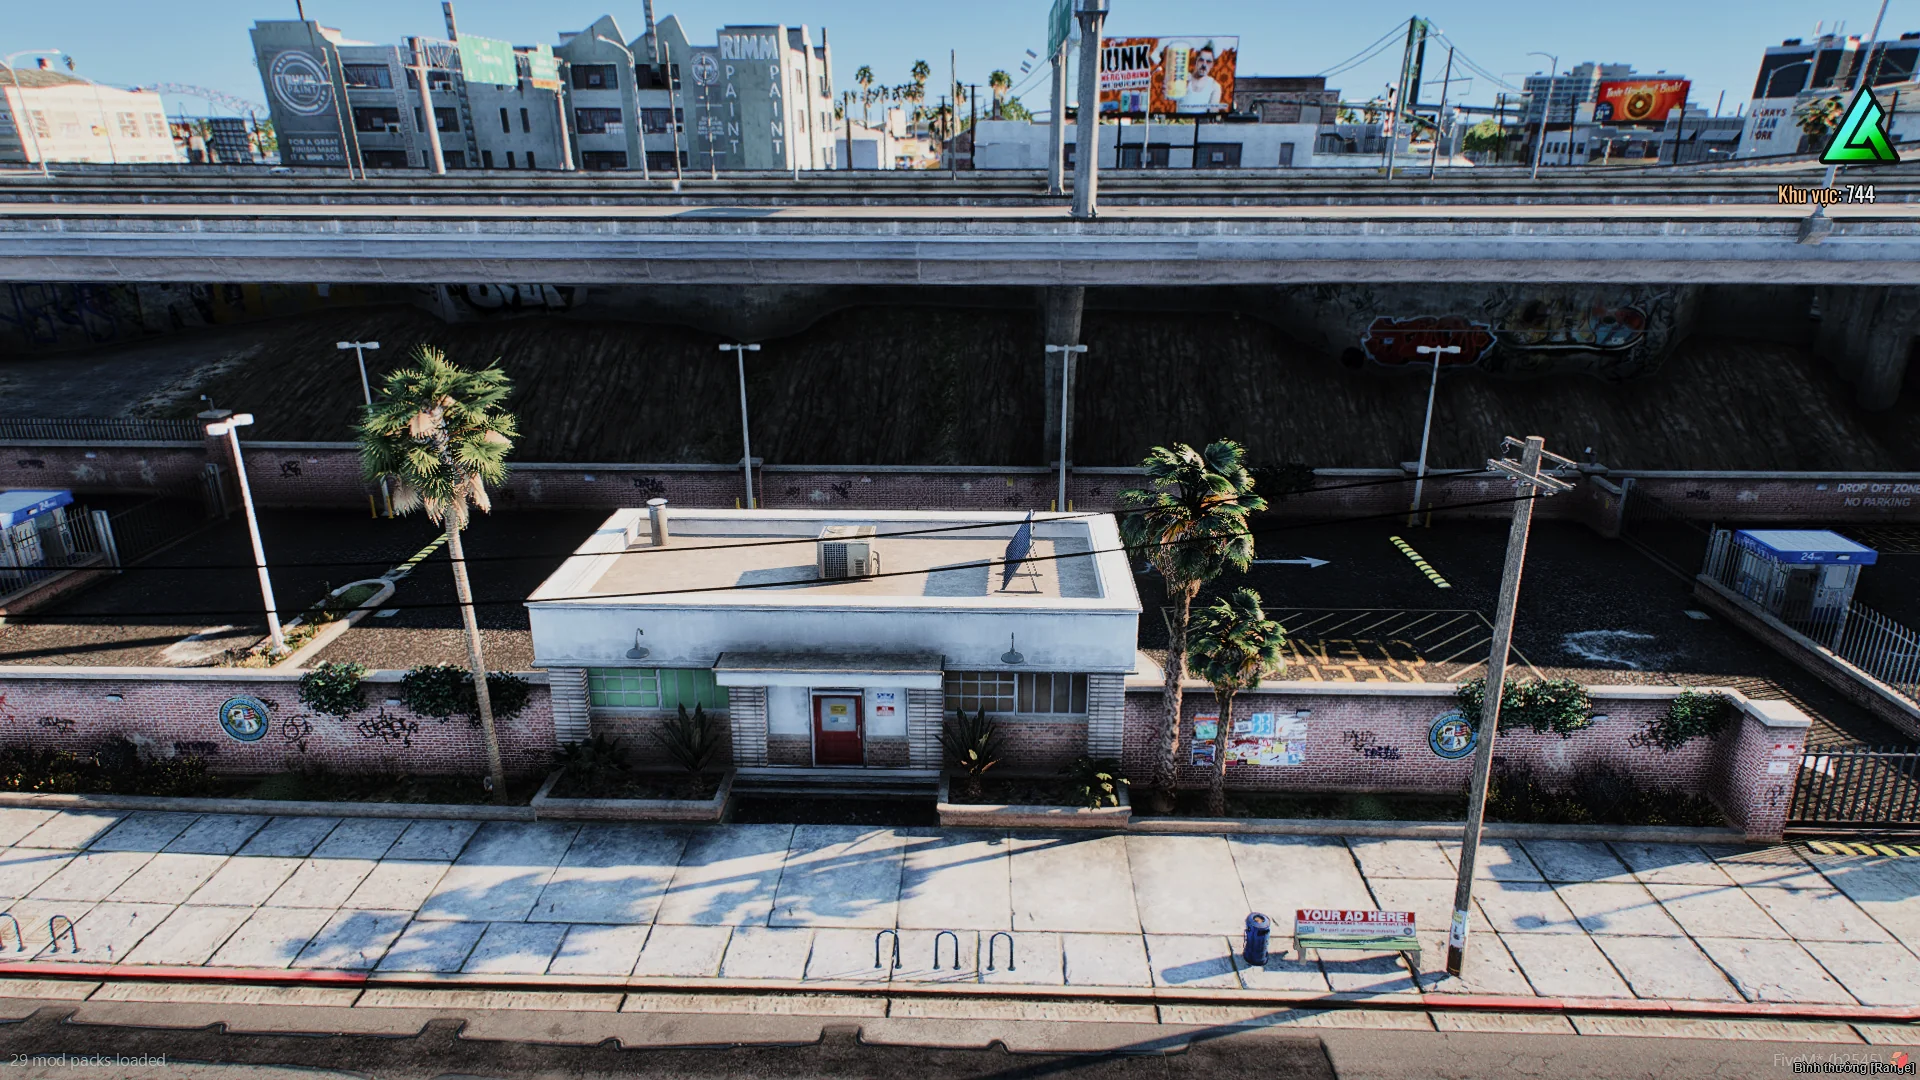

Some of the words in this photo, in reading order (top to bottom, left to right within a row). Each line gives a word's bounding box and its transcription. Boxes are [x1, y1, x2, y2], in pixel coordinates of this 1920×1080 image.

[719, 34, 778, 60] RIMM
[287, 85, 316, 94] PAINT
[726, 64, 739, 154] PAINT
[769, 64, 782, 154] PAINT
[1838, 483, 1868, 493] DROP
[1871, 483, 1892, 493] OFF
[1893, 483, 1920, 494] ZONE
[1844, 497, 1861, 507] NO
[1862, 497, 1911, 507] PARKING
[1800, 552, 1815, 561] 24
[1303, 909, 1341, 920] YOUR
[1345, 910, 1364, 921] AD
[1367, 911, 1408, 922] HERE!
